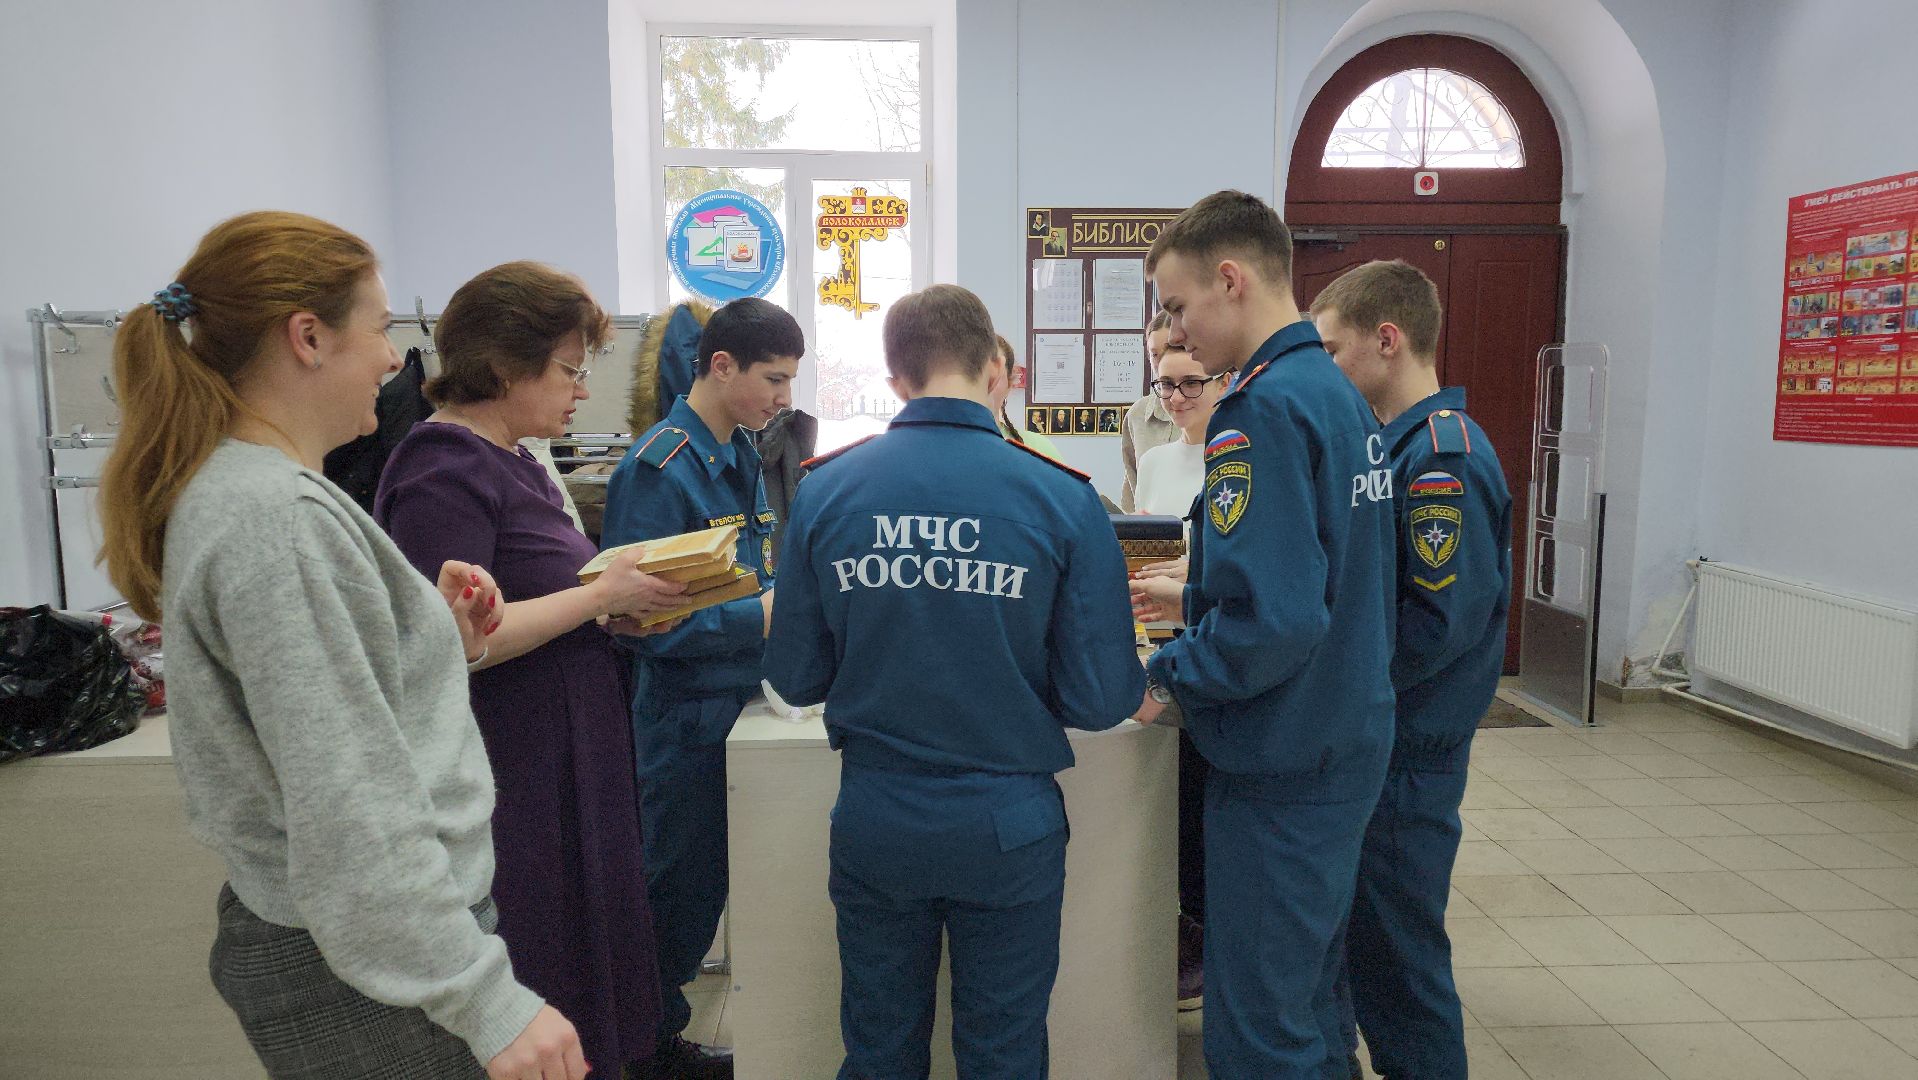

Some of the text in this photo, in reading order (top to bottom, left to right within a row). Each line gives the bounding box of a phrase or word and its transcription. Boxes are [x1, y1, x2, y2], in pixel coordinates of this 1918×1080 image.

[1830, 180, 1903, 203] ДЕЙСТВОВАТЬ
[822, 217, 900, 227] ВОЛОКОЛАМСК
[872, 515, 980, 552] МЧС
[831, 553, 1029, 599] РОССИИ
